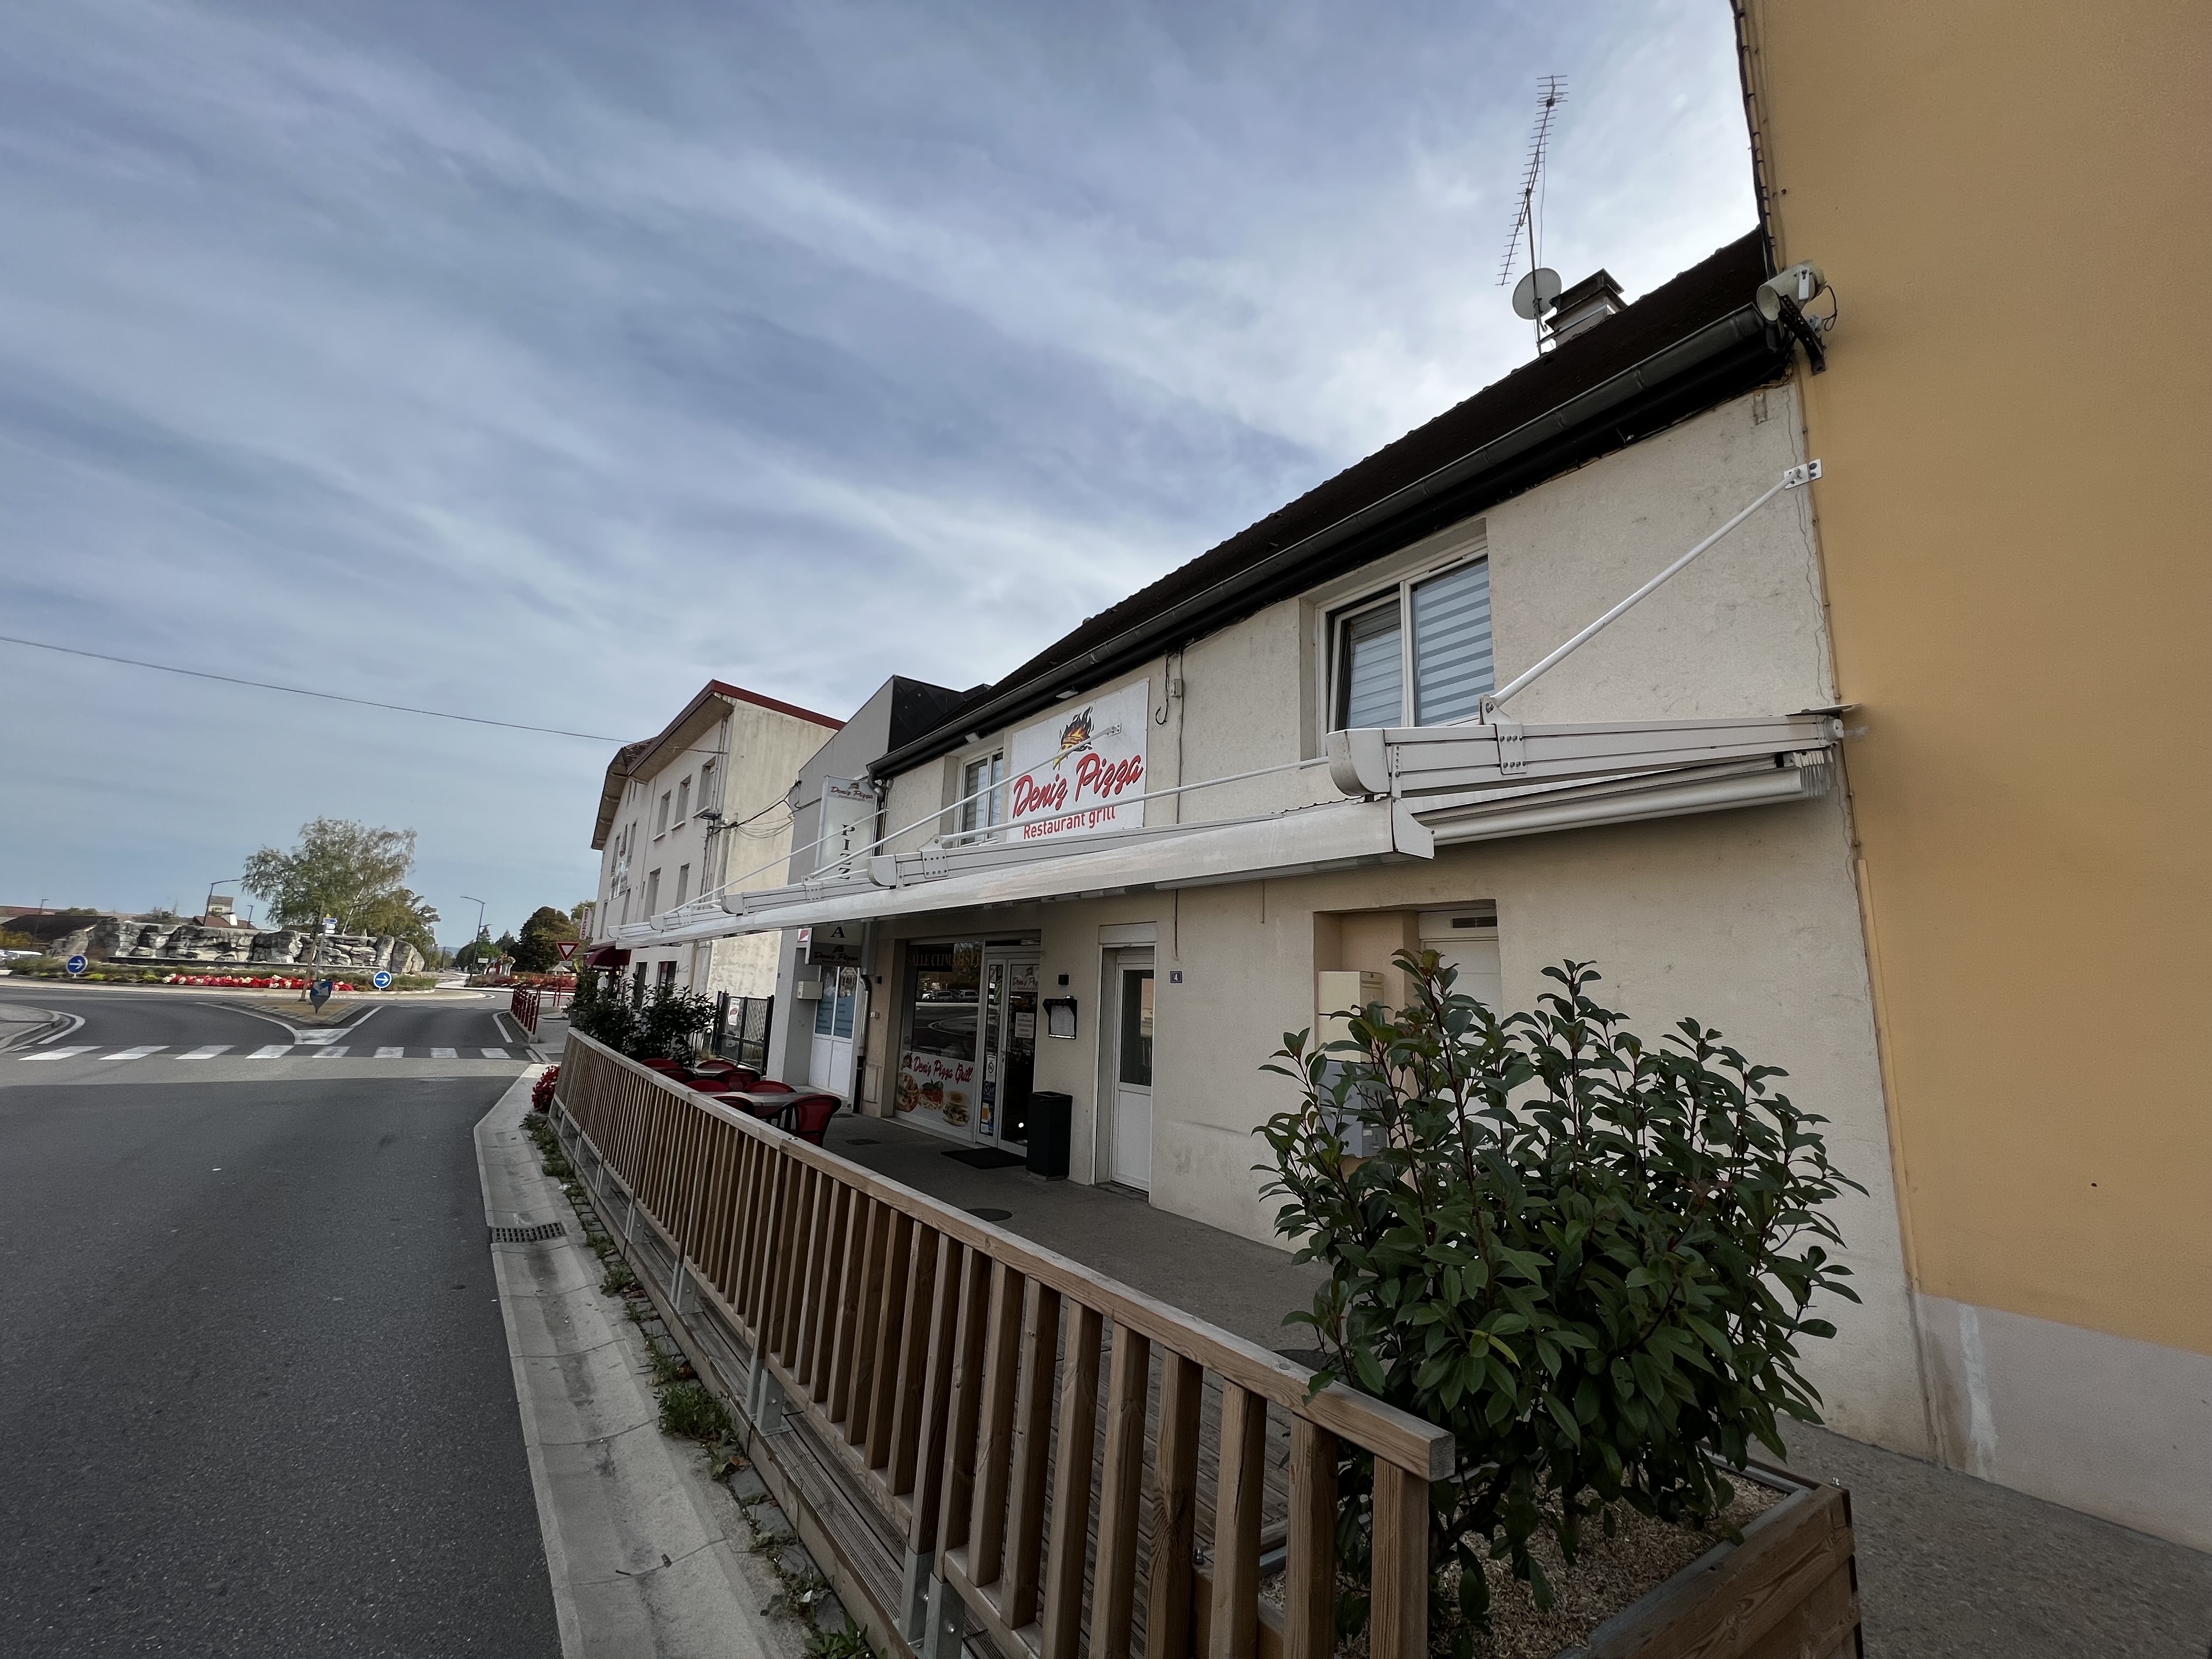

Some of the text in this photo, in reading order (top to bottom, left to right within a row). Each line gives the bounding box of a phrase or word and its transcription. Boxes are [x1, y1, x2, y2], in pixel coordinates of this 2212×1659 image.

[1012, 753, 1143, 820] Deniz Pizza
[1024, 806, 1115, 839] Restaurant grill
[933, 1060, 953, 1080] Pizza
